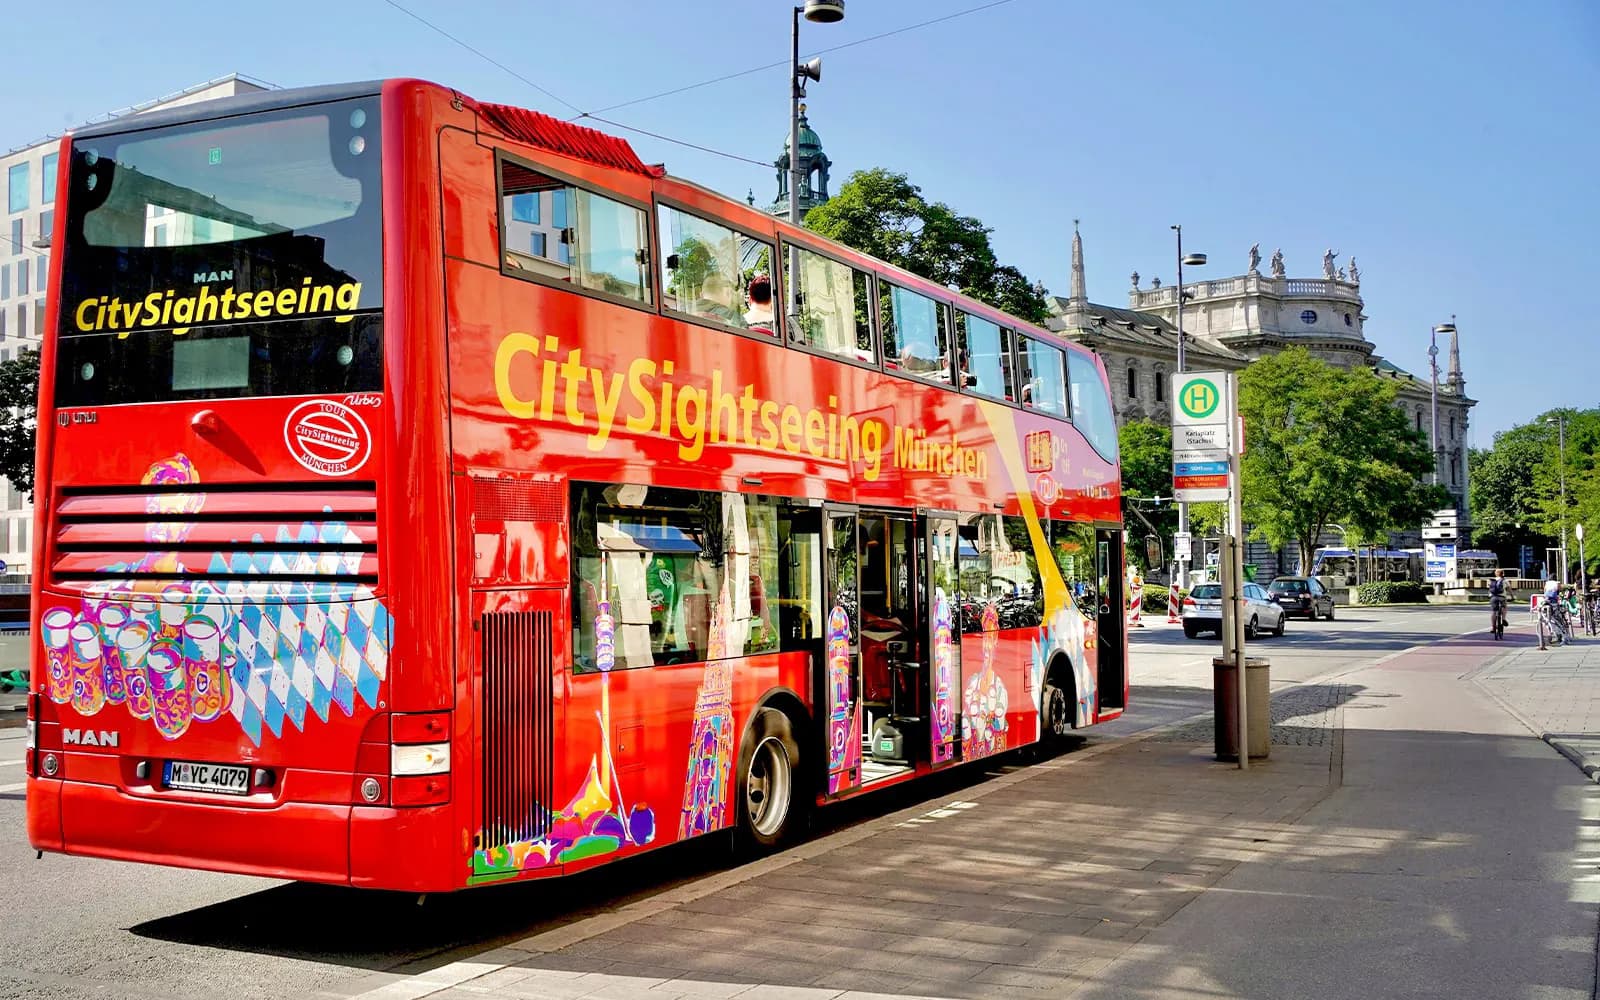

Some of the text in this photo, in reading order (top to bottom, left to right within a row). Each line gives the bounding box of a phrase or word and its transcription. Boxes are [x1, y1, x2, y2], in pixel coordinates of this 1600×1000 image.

[193, 270, 233, 283] MAN
[75, 277, 361, 339] CitySightseeing
[493, 332, 988, 481] CitySightseeing München
[1191, 387, 1208, 410] H
[319, 404, 346, 418] TOUR
[295, 425, 360, 450] CitySightseeing
[63, 728, 118, 747] MAN
[172, 763, 247, 787] M YC 4079
